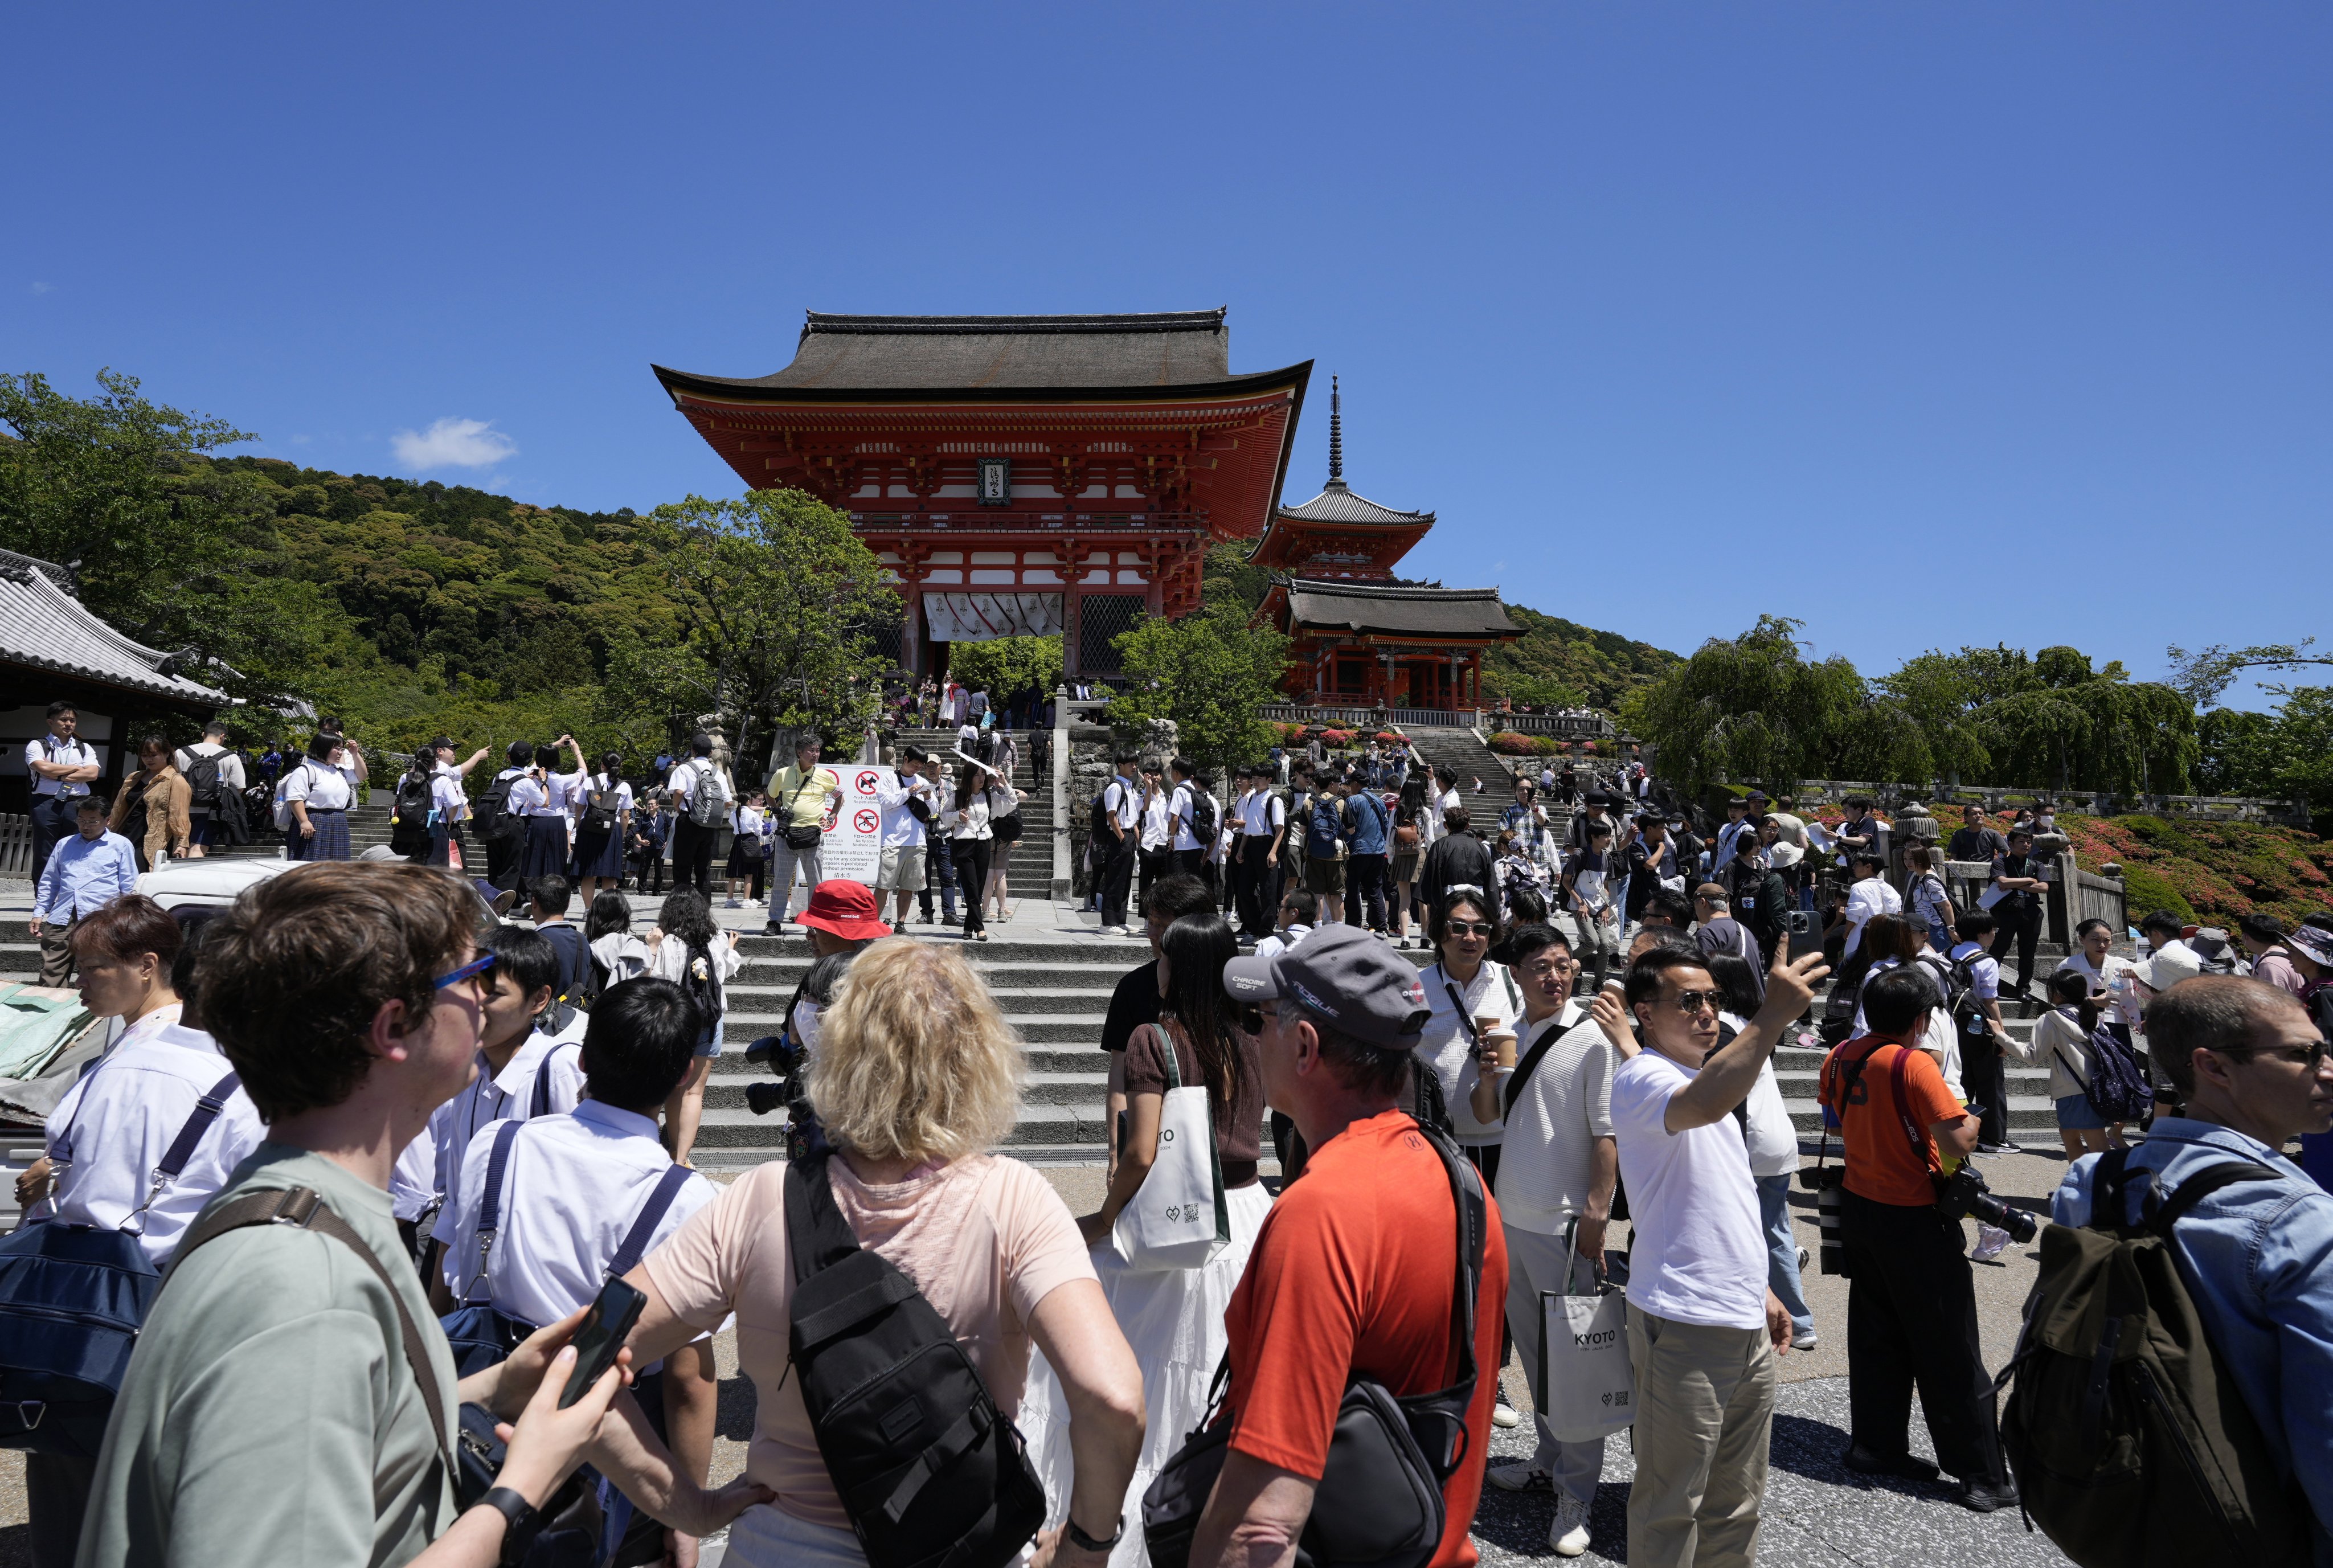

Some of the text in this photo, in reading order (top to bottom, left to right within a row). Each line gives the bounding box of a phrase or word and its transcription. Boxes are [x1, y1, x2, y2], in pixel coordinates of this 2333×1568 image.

[702, 800, 713, 824] balance
[1232, 976, 1266, 986] CHROME
[1236, 982, 1257, 991] SOFT
[1292, 980, 1340, 1017] ROGUE
[1908, 1126, 1919, 1142] EOS
[1575, 1330, 1615, 1345] KYOTO
